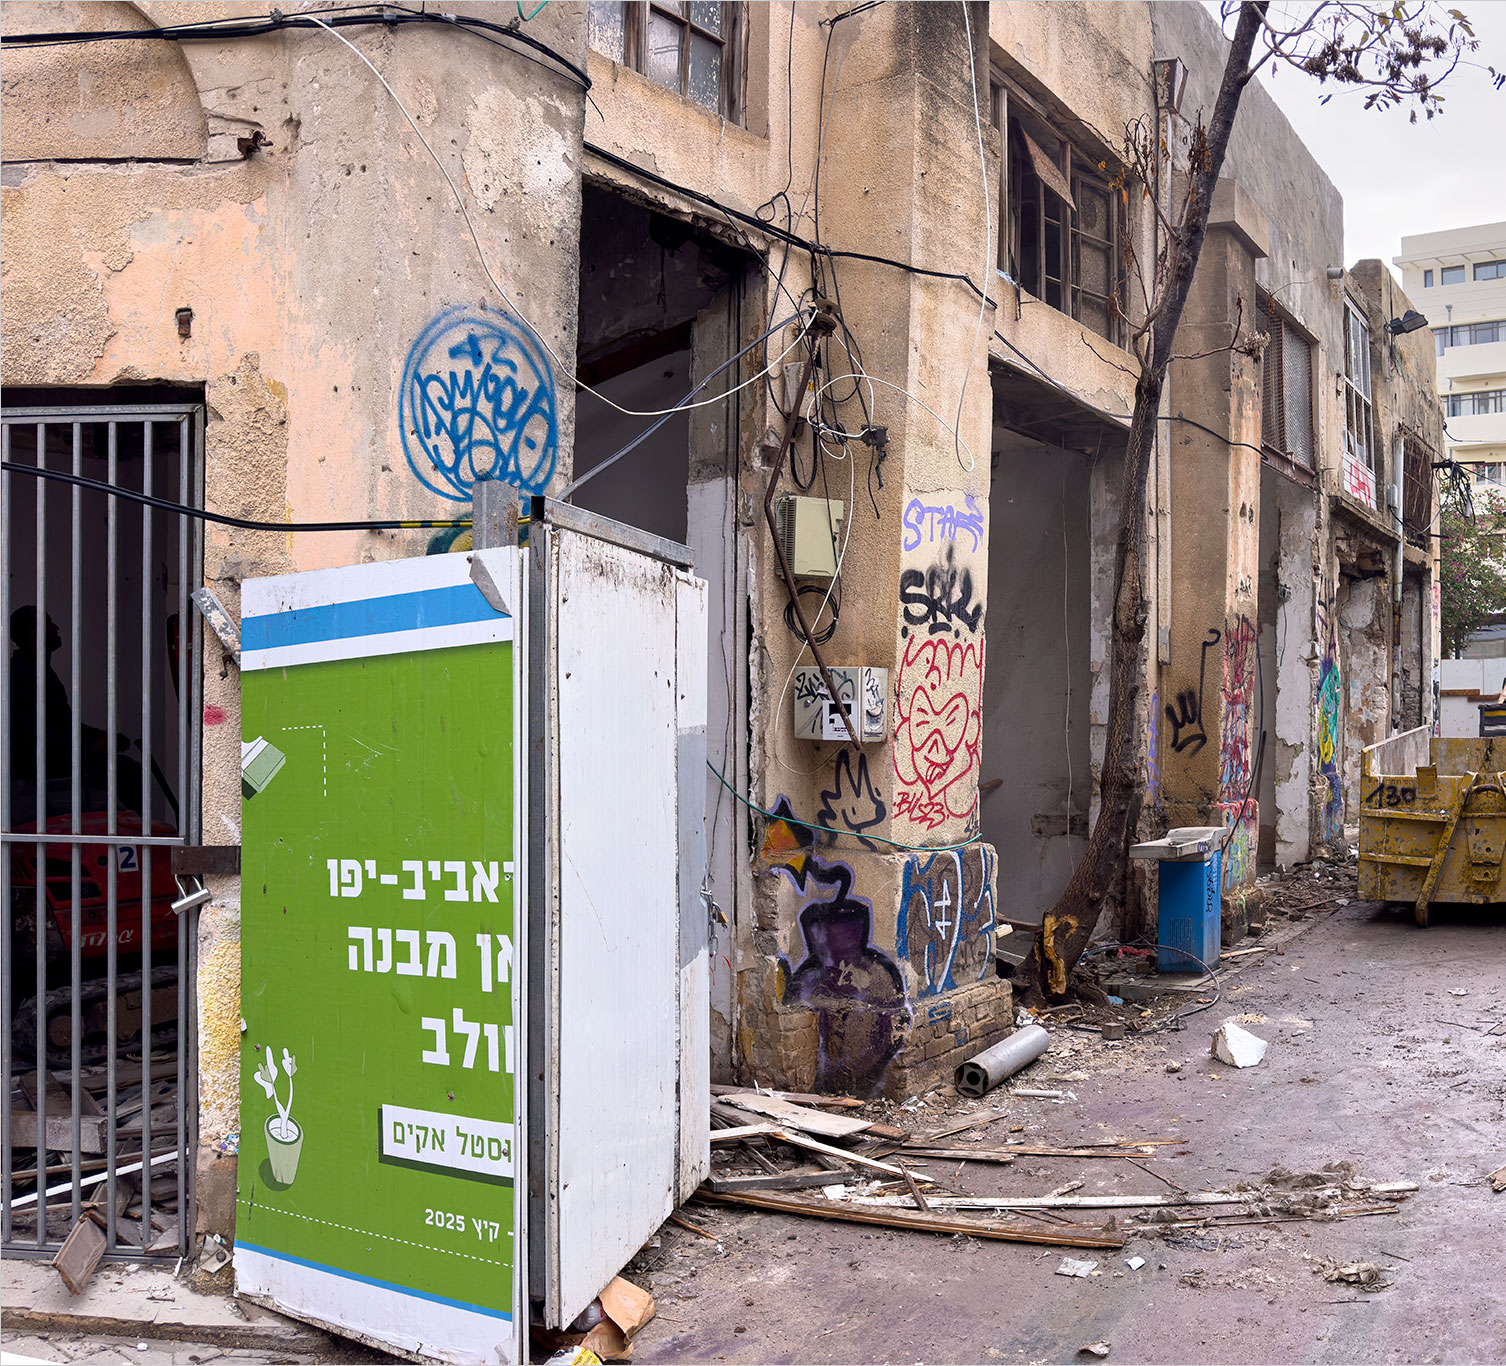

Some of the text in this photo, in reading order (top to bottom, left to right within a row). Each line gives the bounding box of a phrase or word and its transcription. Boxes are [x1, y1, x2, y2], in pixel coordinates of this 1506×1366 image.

[1366, 783, 1416, 808] 130
[119, 846, 136, 869] 2
[348, 926, 457, 979] מבנה
[393, 1121, 445, 1153] אקים
[425, 1208, 500, 1242] קיץ 2025
